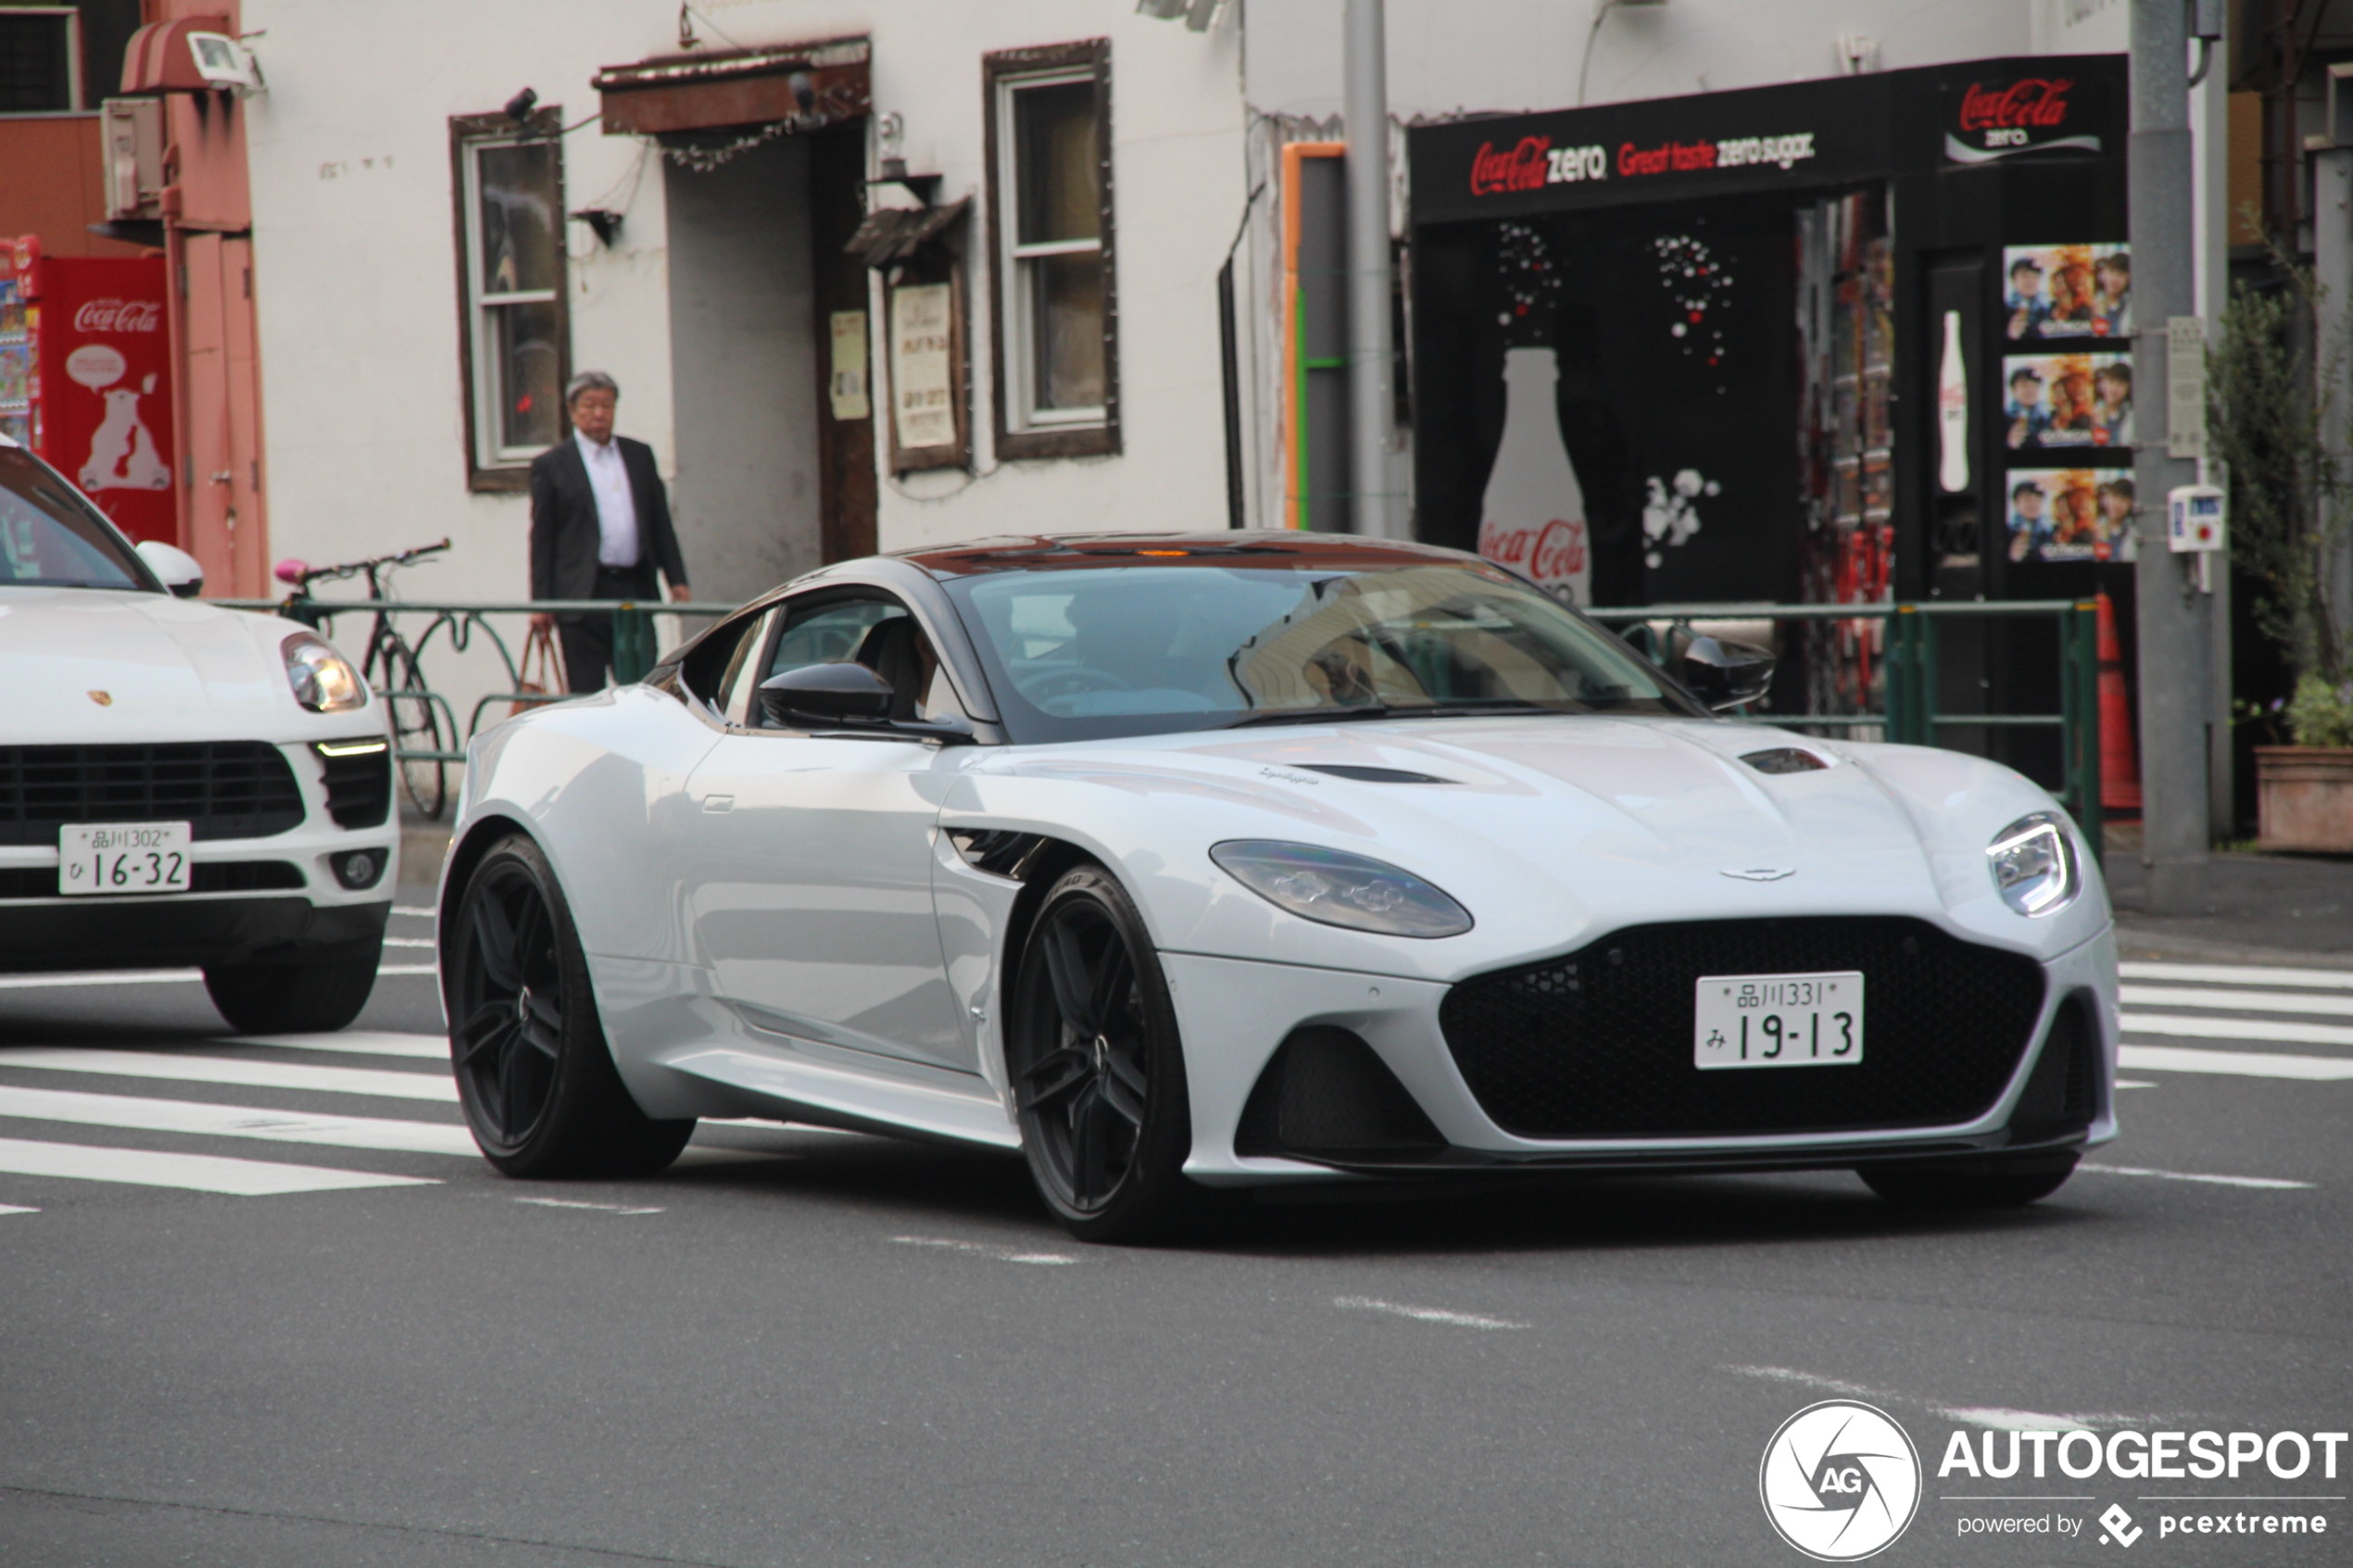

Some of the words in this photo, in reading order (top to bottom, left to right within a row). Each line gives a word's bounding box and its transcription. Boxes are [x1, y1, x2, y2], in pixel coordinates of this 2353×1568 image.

[1546, 144, 1606, 183] zero
[1617, 142, 1670, 177] Great
[1670, 139, 1717, 170] taste
[1717, 137, 1761, 168] zero
[94, 851, 183, 887] 16-32
[1705, 1029, 1727, 1050] み
[1741, 1010, 1854, 1060] 19-13
